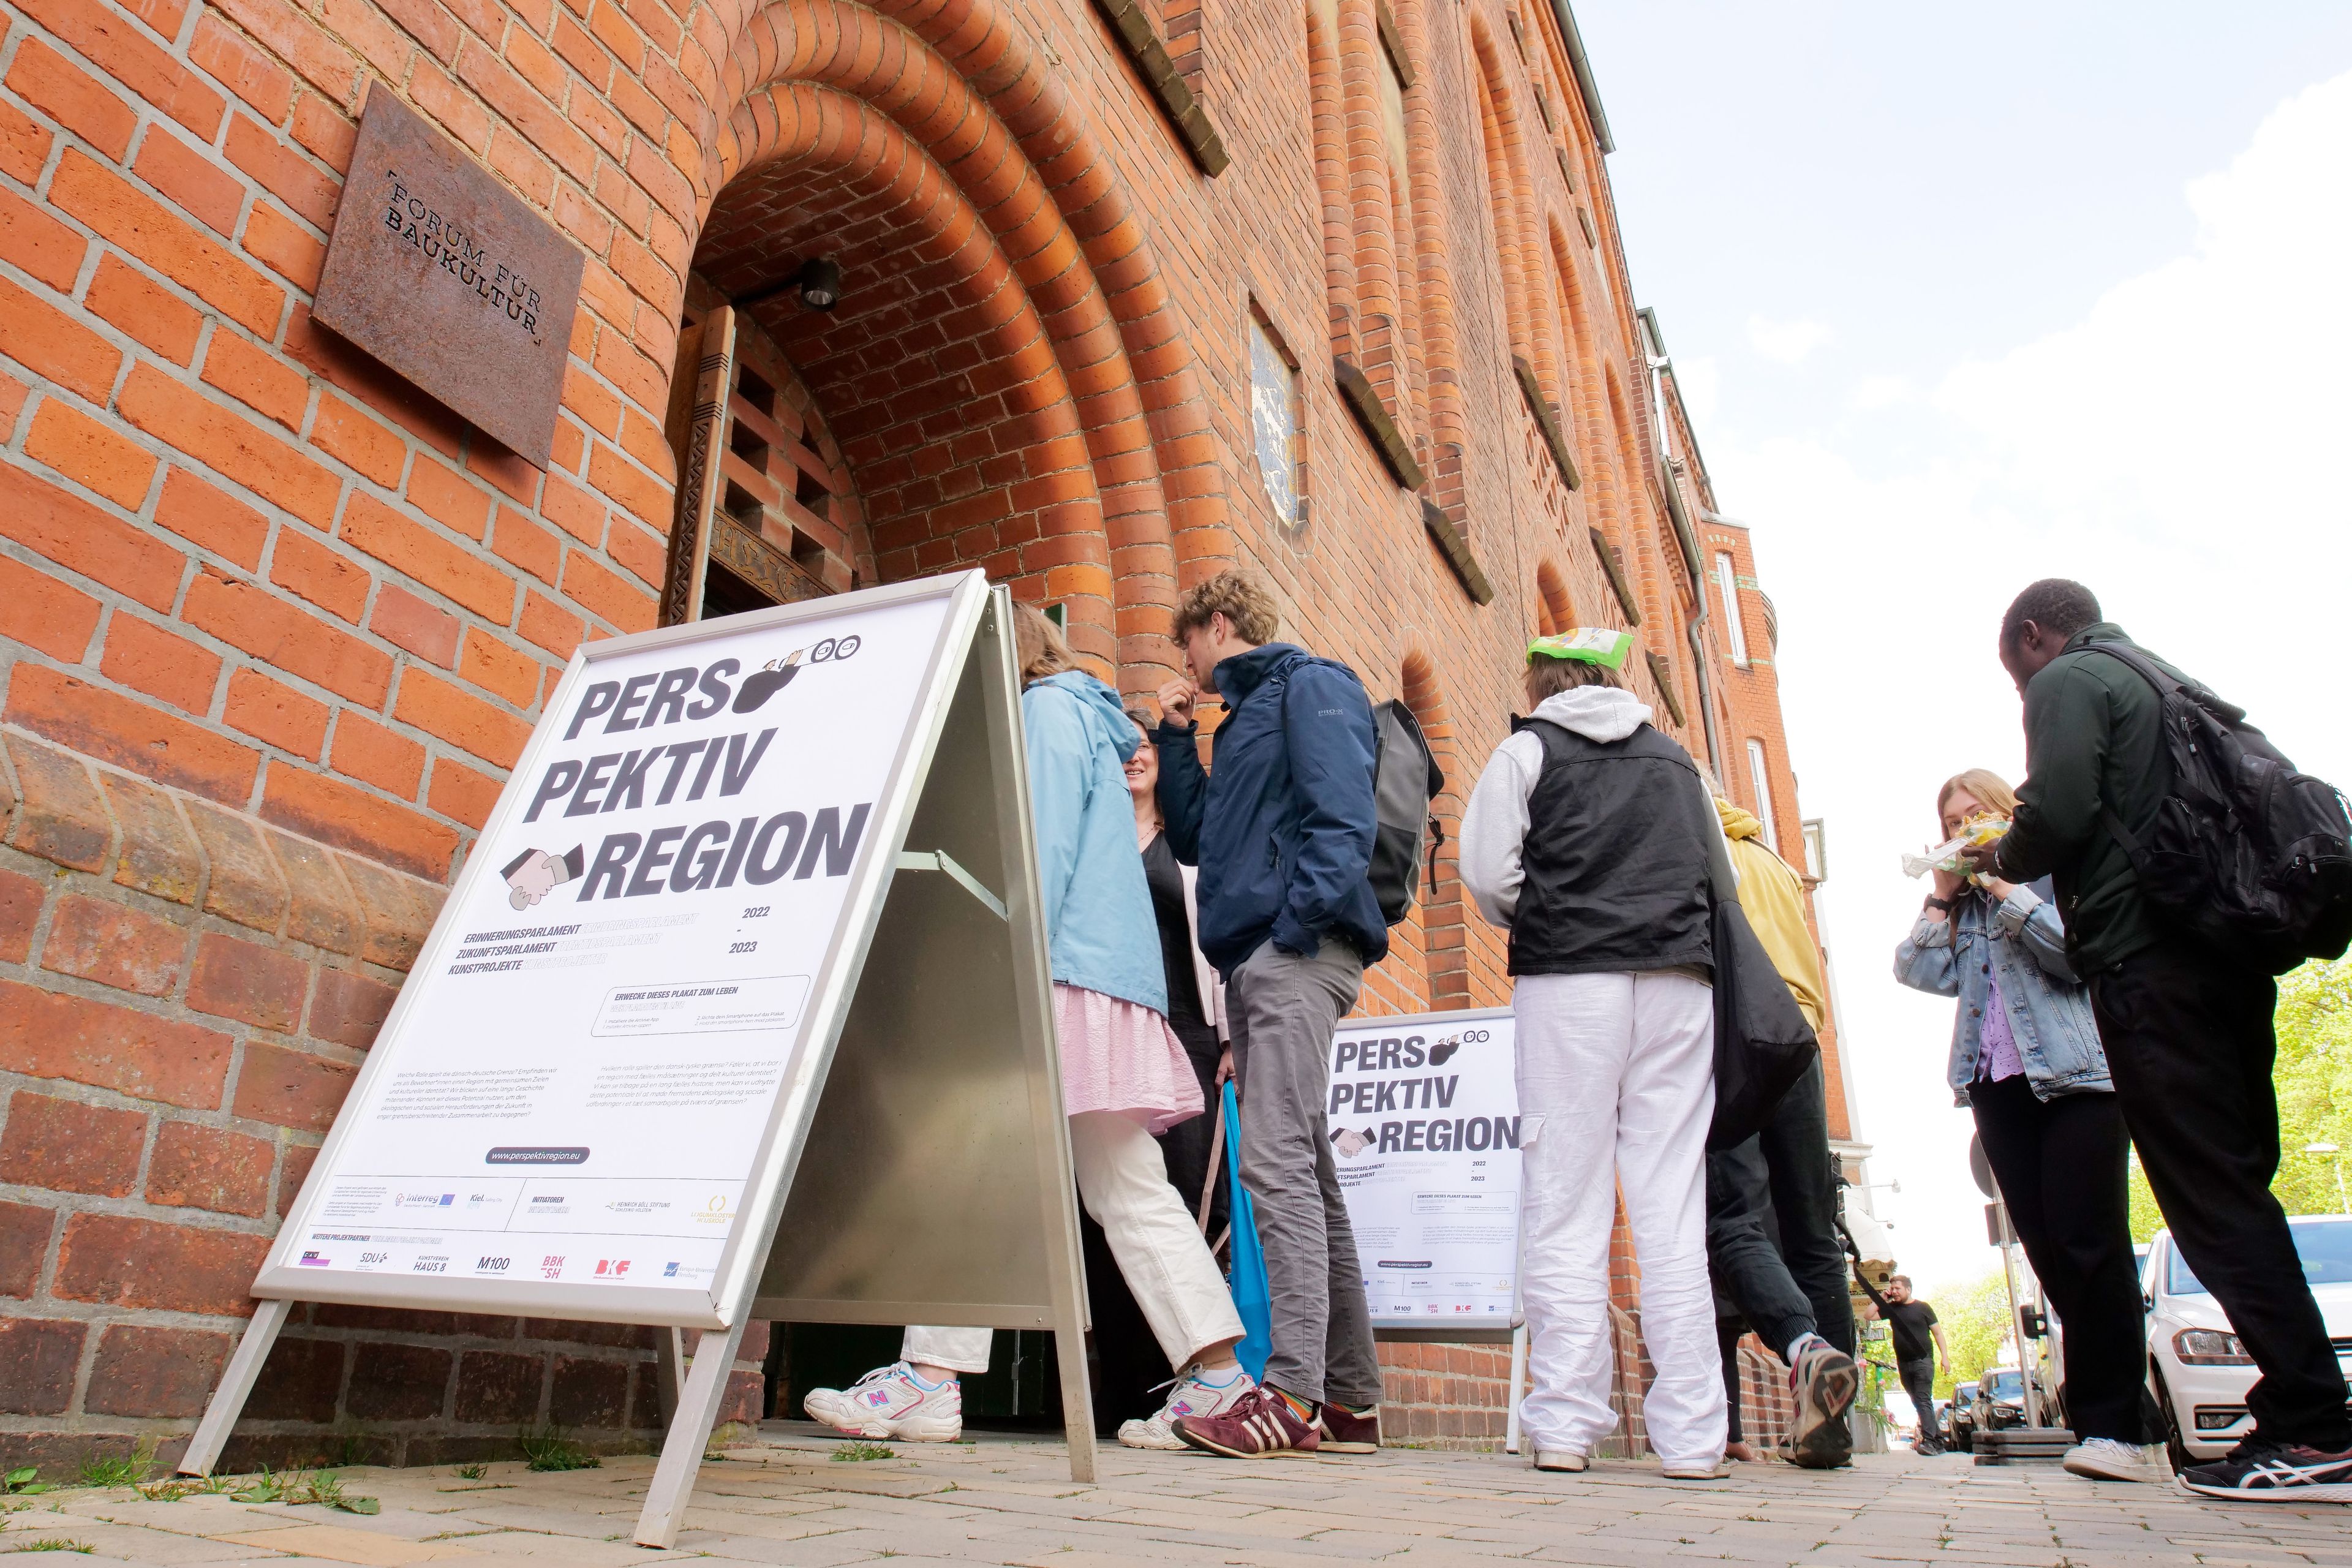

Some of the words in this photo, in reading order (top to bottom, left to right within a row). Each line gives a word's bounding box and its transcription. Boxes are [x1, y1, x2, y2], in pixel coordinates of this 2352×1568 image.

[390, 183, 486, 269] FORUM
[495, 263, 540, 314] FÜR
[385, 206, 538, 336] BAUKULTUR
[560, 656, 745, 741] PERS
[521, 728, 778, 823] PEKTIV
[575, 802, 872, 902] REGION
[742, 907, 771, 919] 2022
[464, 924, 582, 943] ERINNERUNGSPARLAMENT
[455, 942, 557, 959] ZUKUNFTSPARLAMENT
[728, 941, 758, 954] 2023
[447, 960, 524, 974] KUNSTPROJEKTE
[1335, 1035, 1426, 1073] PERS
[1329, 1074, 1459, 1115] PEKTIV
[1378, 1116, 1520, 1153] REGION
[490, 1151, 581, 1161] www.perspektivregion.eu
[405, 1194, 440, 1203] Interreg
[359, 1253, 380, 1262] SDU
[477, 1257, 511, 1270] M100
[542, 1256, 566, 1267] BBK
[412, 1262, 439, 1272] HAUS
[438, 1263, 447, 1272] 8
[867, 1390, 889, 1407] N
[1170, 1401, 1193, 1417] N
